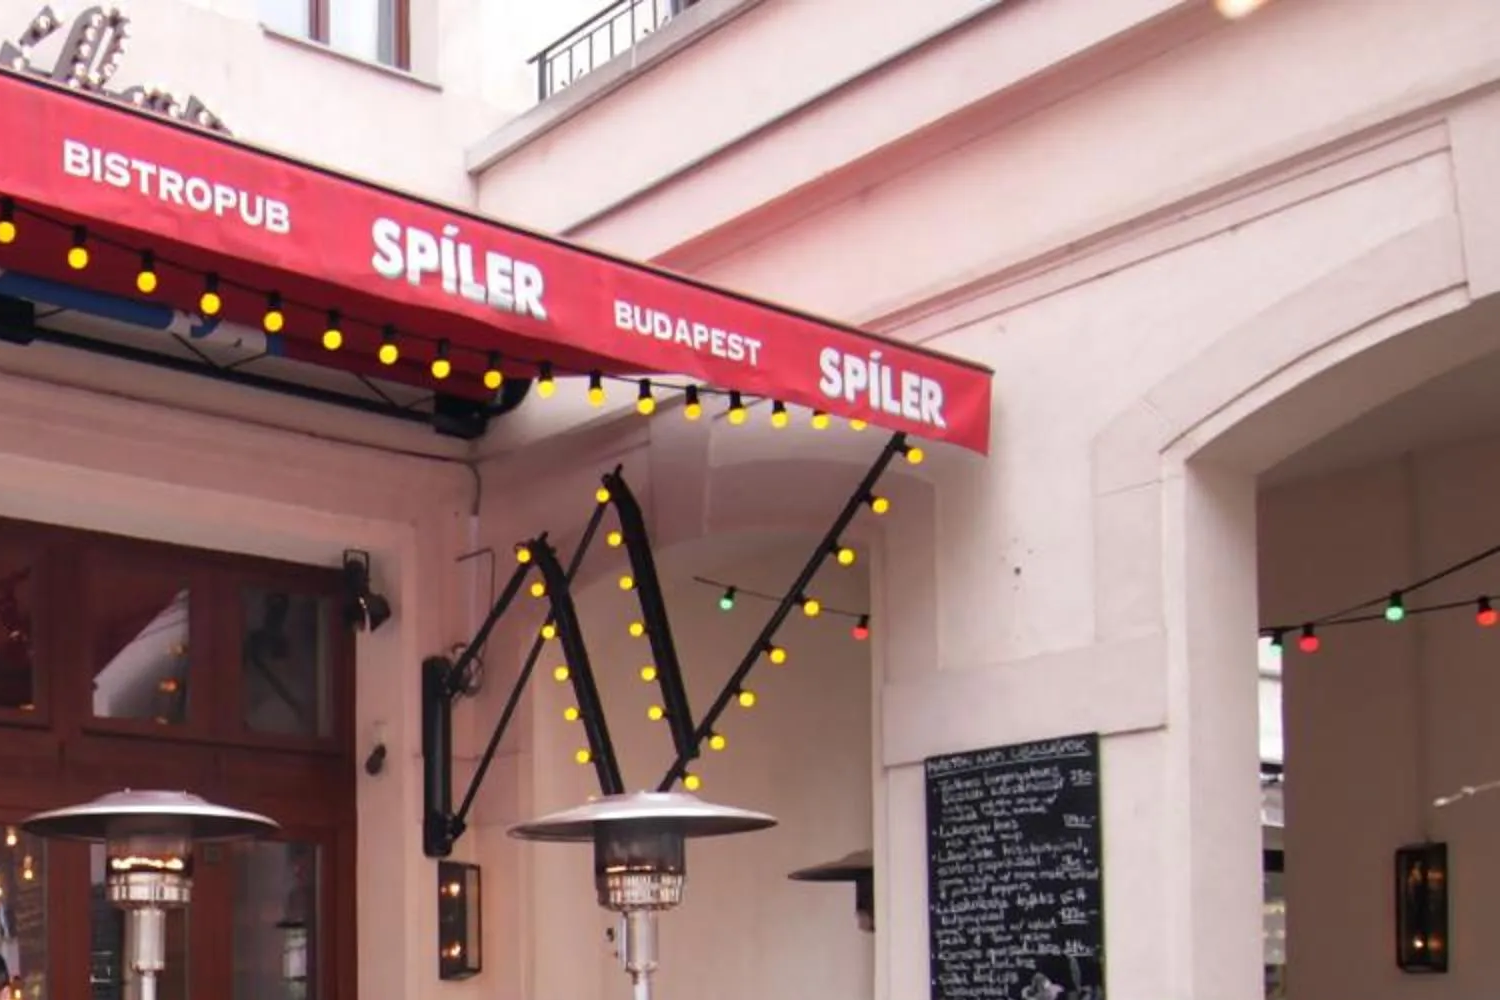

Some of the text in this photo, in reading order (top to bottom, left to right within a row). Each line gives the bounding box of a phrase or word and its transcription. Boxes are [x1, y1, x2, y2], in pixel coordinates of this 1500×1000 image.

[63, 139, 292, 234] BISTROPUB
[372, 217, 548, 320] SPÍLER
[614, 300, 762, 367] BUDAPEST
[819, 348, 946, 428] SPÍLER
